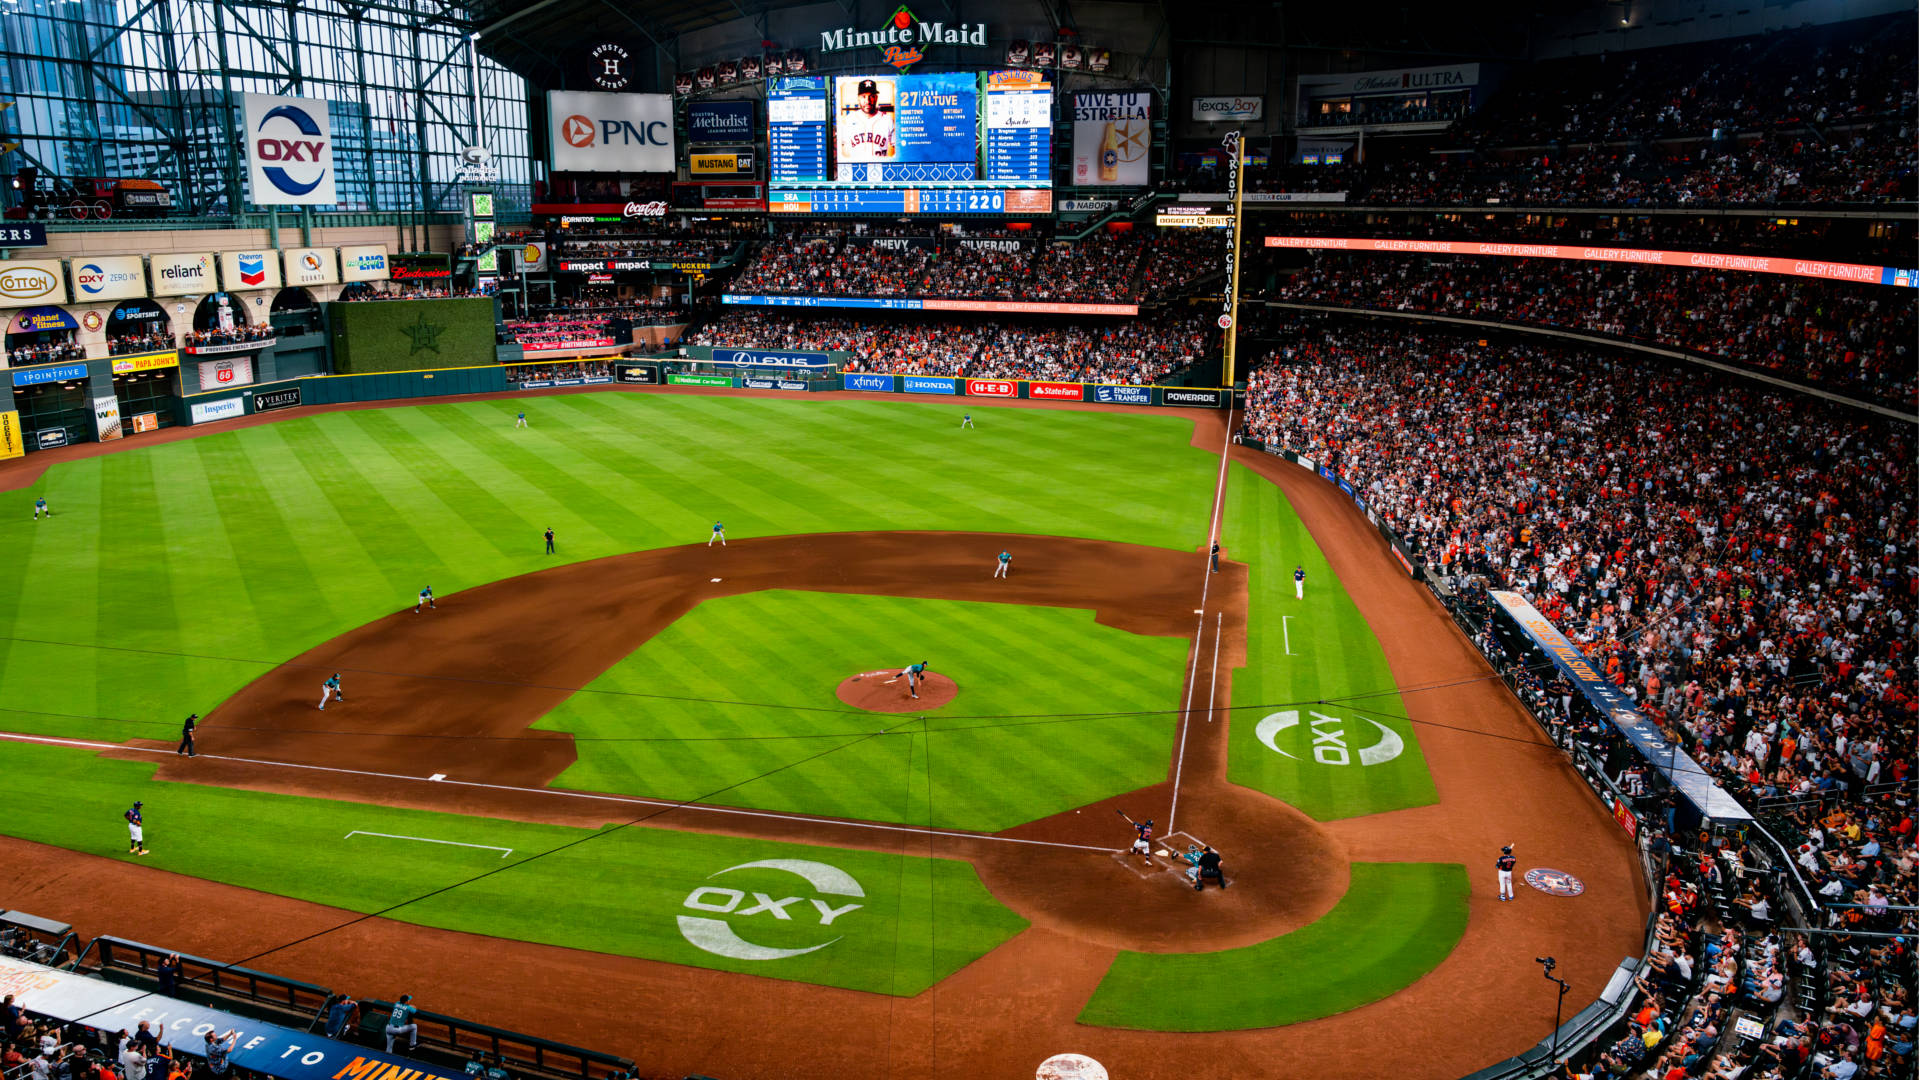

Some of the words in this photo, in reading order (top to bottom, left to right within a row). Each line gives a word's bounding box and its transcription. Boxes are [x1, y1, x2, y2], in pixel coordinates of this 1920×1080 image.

[820, 25, 913, 52] Minute
[918, 22, 987, 46] Maid
[592, 43, 628, 59] HOUSTON
[882, 46, 923, 69] Park
[603, 59, 620, 75] H
[595, 76, 628, 89] ASTROS
[996, 69, 1034, 84] ASTROS
[1411, 71, 1465, 88] ULTRA
[900, 91, 919, 107] 27
[921, 95, 958, 107] ALTUVE
[1116, 92, 1138, 107] TU
[1074, 106, 1151, 121] ESTRELLA!
[1198, 99, 1230, 112] Texas
[1231, 98, 1259, 116] Bay
[692, 114, 749, 128] Methodist
[598, 119, 669, 146] PNC
[851, 132, 887, 148] ASTROS
[257, 138, 326, 163] OXY
[697, 159, 734, 169] MUSTANG
[738, 158, 752, 169] CAT
[1227, 159, 1238, 200] ROOT
[783, 193, 799, 201] SEA
[783, 203, 800, 211] HOU
[1226, 203, 1235, 214] 4
[1225, 218, 1235, 249] THA
[873, 239, 909, 251] CHEVY
[960, 240, 1021, 253] SILVERADO
[1271, 237, 1305, 247] GALLERY
[1305, 238, 1348, 248] FURNITURE
[1374, 240, 1408, 250] GALLERY
[1408, 241, 1452, 252] FURNITURE
[1479, 243, 1512, 254] GALLERY
[1513, 244, 1559, 256] FURNITURE
[1584, 248, 1619, 260] GALLERY
[1620, 250, 1664, 262] FURNITURE
[238, 253, 263, 261] Chevron
[358, 254, 385, 271] LNG
[1691, 254, 1726, 266] GALLERY
[1725, 256, 1769, 270] FURNITURE
[160, 264, 204, 279] reliant
[567, 260, 604, 272] impact
[614, 259, 650, 271] impact
[671, 262, 711, 270] PLUCKERS
[1795, 262, 1829, 275] GALLERY
[1828, 264, 1875, 281] FURNITURE
[78, 274, 104, 283] OXY
[109, 272, 129, 282] ZERO
[301, 274, 326, 283] QUANTA
[390, 267, 451, 280] Budweiser
[1, 276, 48, 292] COTTON
[1223, 253, 1235, 313] CHIKIN
[805, 297, 811, 306] K
[925, 301, 952, 309] GALLERY
[952, 302, 987, 310] FURNITURE
[1024, 304, 1059, 312] FURNITURE
[126, 311, 161, 320] SPORTSNET
[1097, 305, 1134, 313] FURNITURE
[32, 313, 60, 326] planet
[36, 320, 65, 330] fitness
[205, 345, 232, 353] PROVIDING
[135, 359, 153, 369] PAPA
[153, 357, 176, 367] JOHN'S
[752, 356, 809, 367] LEXUS
[23, 368, 80, 383] 1POINTFIVE
[218, 370, 231, 380] 66
[680, 376, 701, 384] National
[853, 377, 886, 389] xfinity
[915, 382, 954, 390] HONDA
[1113, 387, 1141, 395] ENERGY
[1167, 393, 1216, 402] POWERADE
[265, 392, 298, 404] VERITEX
[97, 409, 118, 419] WM
[204, 402, 236, 414] Insperity
[41, 439, 65, 448] CHEVROLET
[1309, 710, 1351, 765] OXY
[683, 886, 865, 925] OXY
[392, 1008, 403, 1019] 89
[280, 1044, 325, 1066] TO
[148, 1063, 154, 1074] 5
